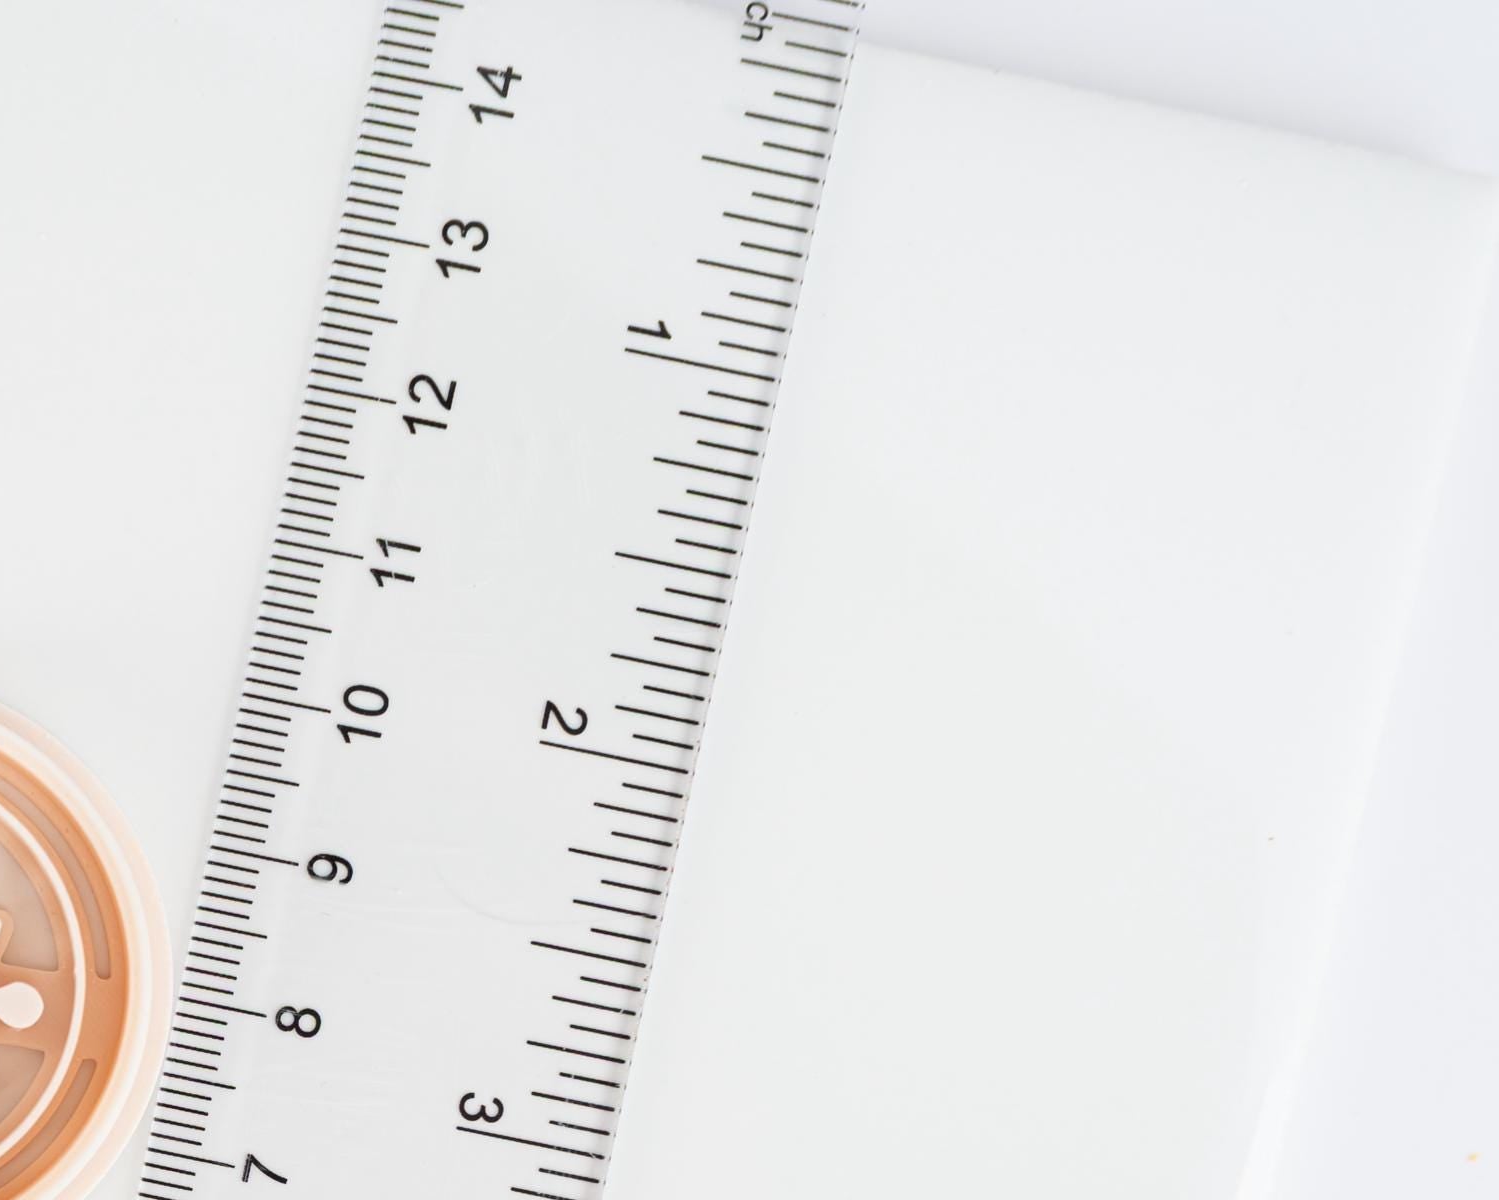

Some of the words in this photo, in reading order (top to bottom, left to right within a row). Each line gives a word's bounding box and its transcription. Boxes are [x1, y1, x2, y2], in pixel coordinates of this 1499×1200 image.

[468, 66, 523, 124] 14
[435, 219, 489, 279] 13
[627, 320, 672, 340] 1
[402, 373, 457, 435] 12
[369, 537, 422, 588] 11
[336, 684, 390, 744] 10
[541, 700, 589, 736] 2
[306, 853, 354, 885] 9
[274, 1005, 322, 1039] 8
[458, 1092, 505, 1124] 3
[241, 1153, 288, 1185] 7
